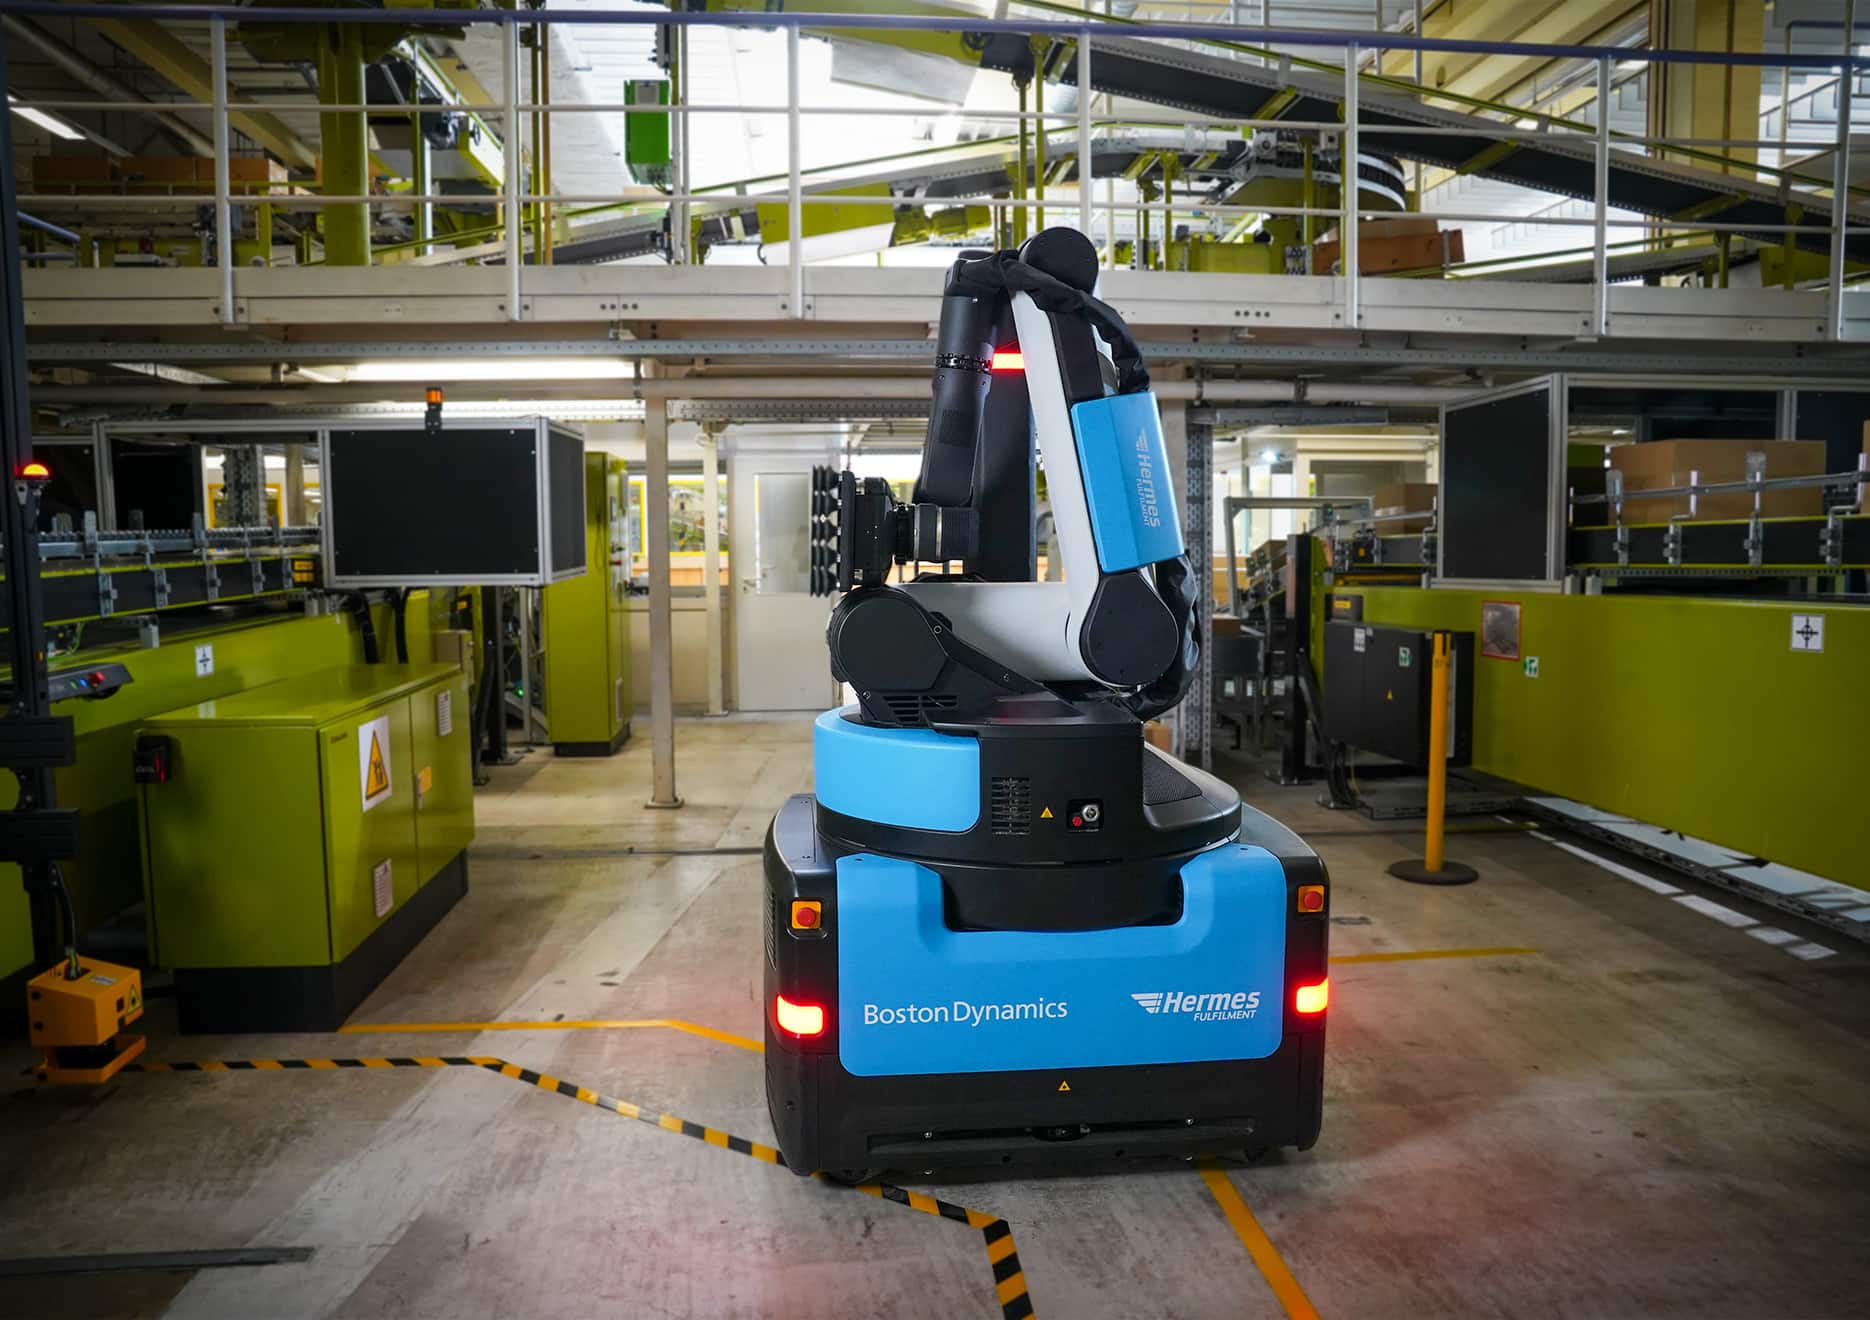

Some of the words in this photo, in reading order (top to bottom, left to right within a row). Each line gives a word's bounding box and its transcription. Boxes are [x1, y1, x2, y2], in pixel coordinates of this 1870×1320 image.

[1137, 454, 1160, 528] Hermes
[864, 1003, 949, 1025] Boston
[953, 997, 1068, 1027] Dynamics
[1162, 991, 1261, 1013] Hermes
[1193, 1010, 1256, 1022] FULFILMENT
